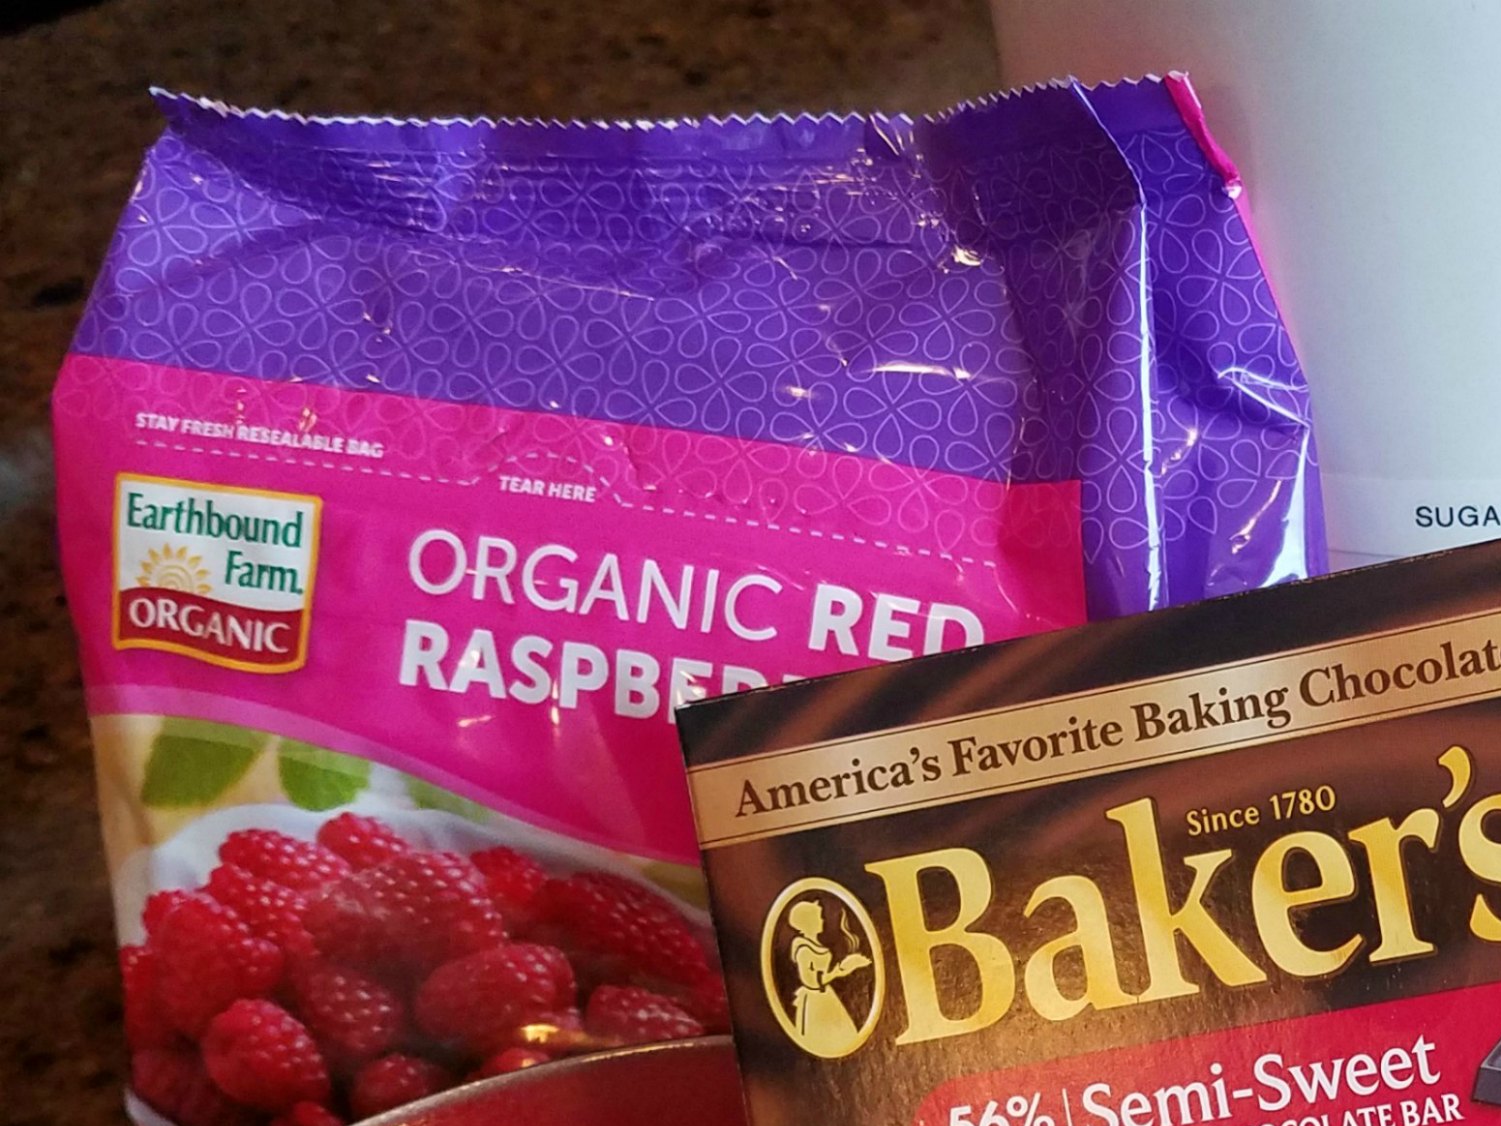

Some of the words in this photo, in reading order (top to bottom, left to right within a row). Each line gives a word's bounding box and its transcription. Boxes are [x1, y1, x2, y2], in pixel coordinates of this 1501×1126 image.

[136, 413, 177, 432] STAY
[181, 418, 236, 439] FRESH
[236, 424, 345, 454] RESEALABLE
[346, 439, 385, 459] BAG
[500, 475, 546, 498] TEAR
[549, 480, 597, 503] HERE
[127, 492, 304, 548] Earthbound
[408, 529, 785, 642] ORGANIC
[807, 583, 985, 662] RED
[128, 597, 292, 654] ORGANIC
[399, 619, 809, 724] RASPBE
[734, 744, 943, 820] America's
[950, 716, 1124, 777] Favorite
[1131, 680, 1292, 741] Baking
[1186, 802, 1261, 838] Since
[1268, 785, 1336, 821] 1780
